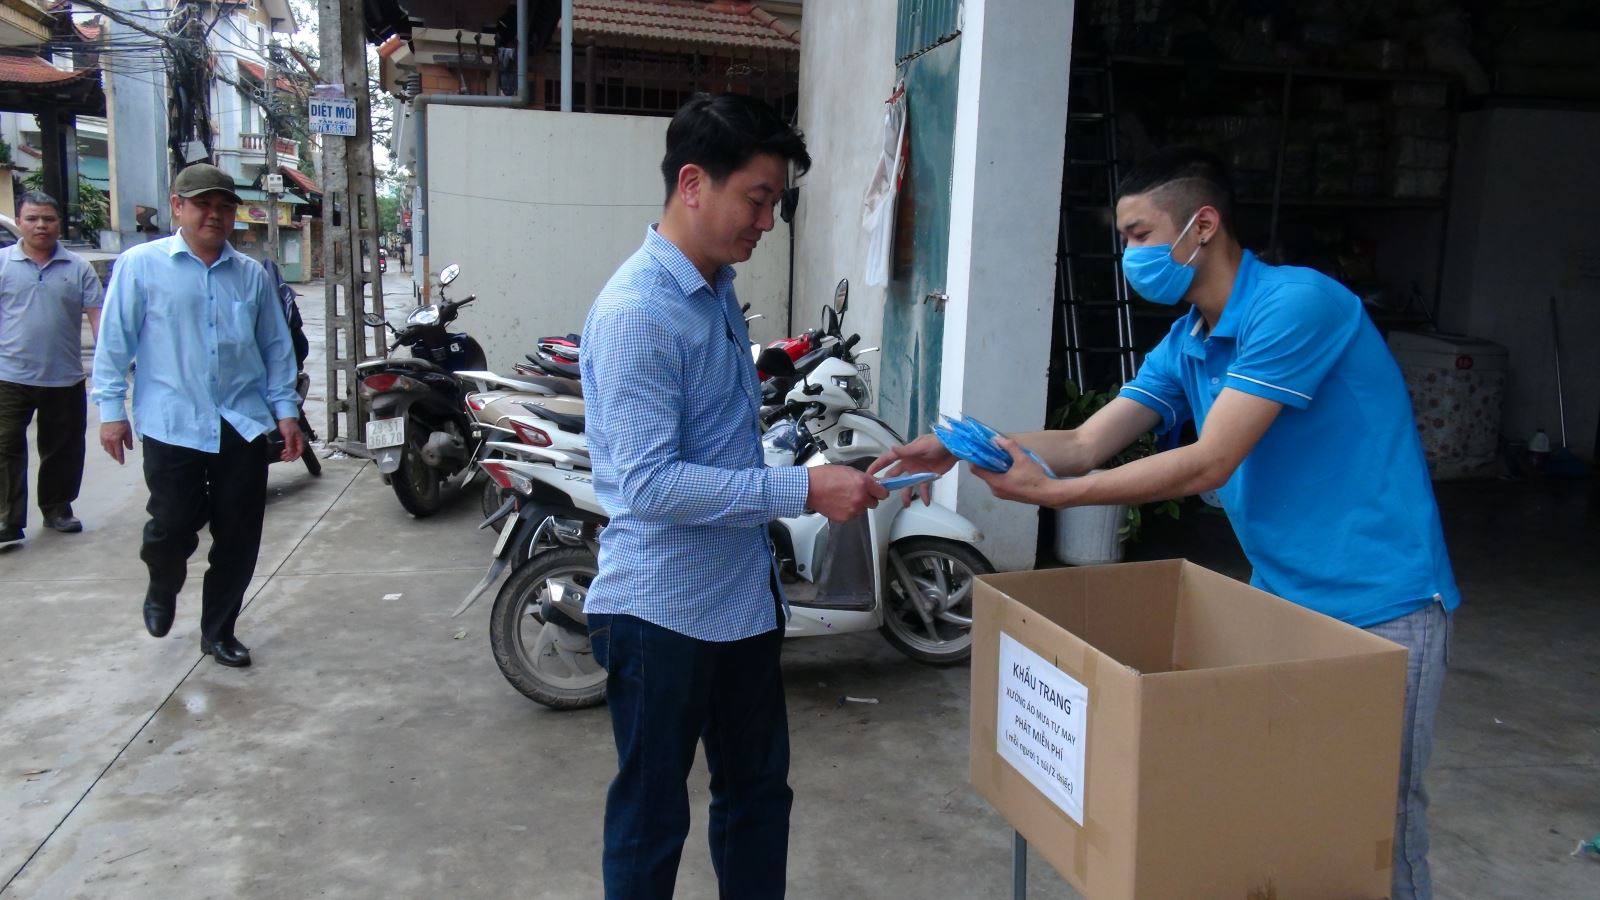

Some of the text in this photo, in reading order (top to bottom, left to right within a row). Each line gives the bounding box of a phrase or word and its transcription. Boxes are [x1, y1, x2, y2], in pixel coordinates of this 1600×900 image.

[336, 104, 355, 120] MỐI
[1013, 661, 1072, 715] KHẨU TRANG
[1015, 714, 1031, 735] PHÁT
[1051, 743, 1063, 761] PHÍ
[1026, 700, 1035, 715] ÁO
[1036, 709, 1049, 727] MƯA
[1051, 720, 1060, 736] TỰ
[1061, 728, 1076, 746] MAY
